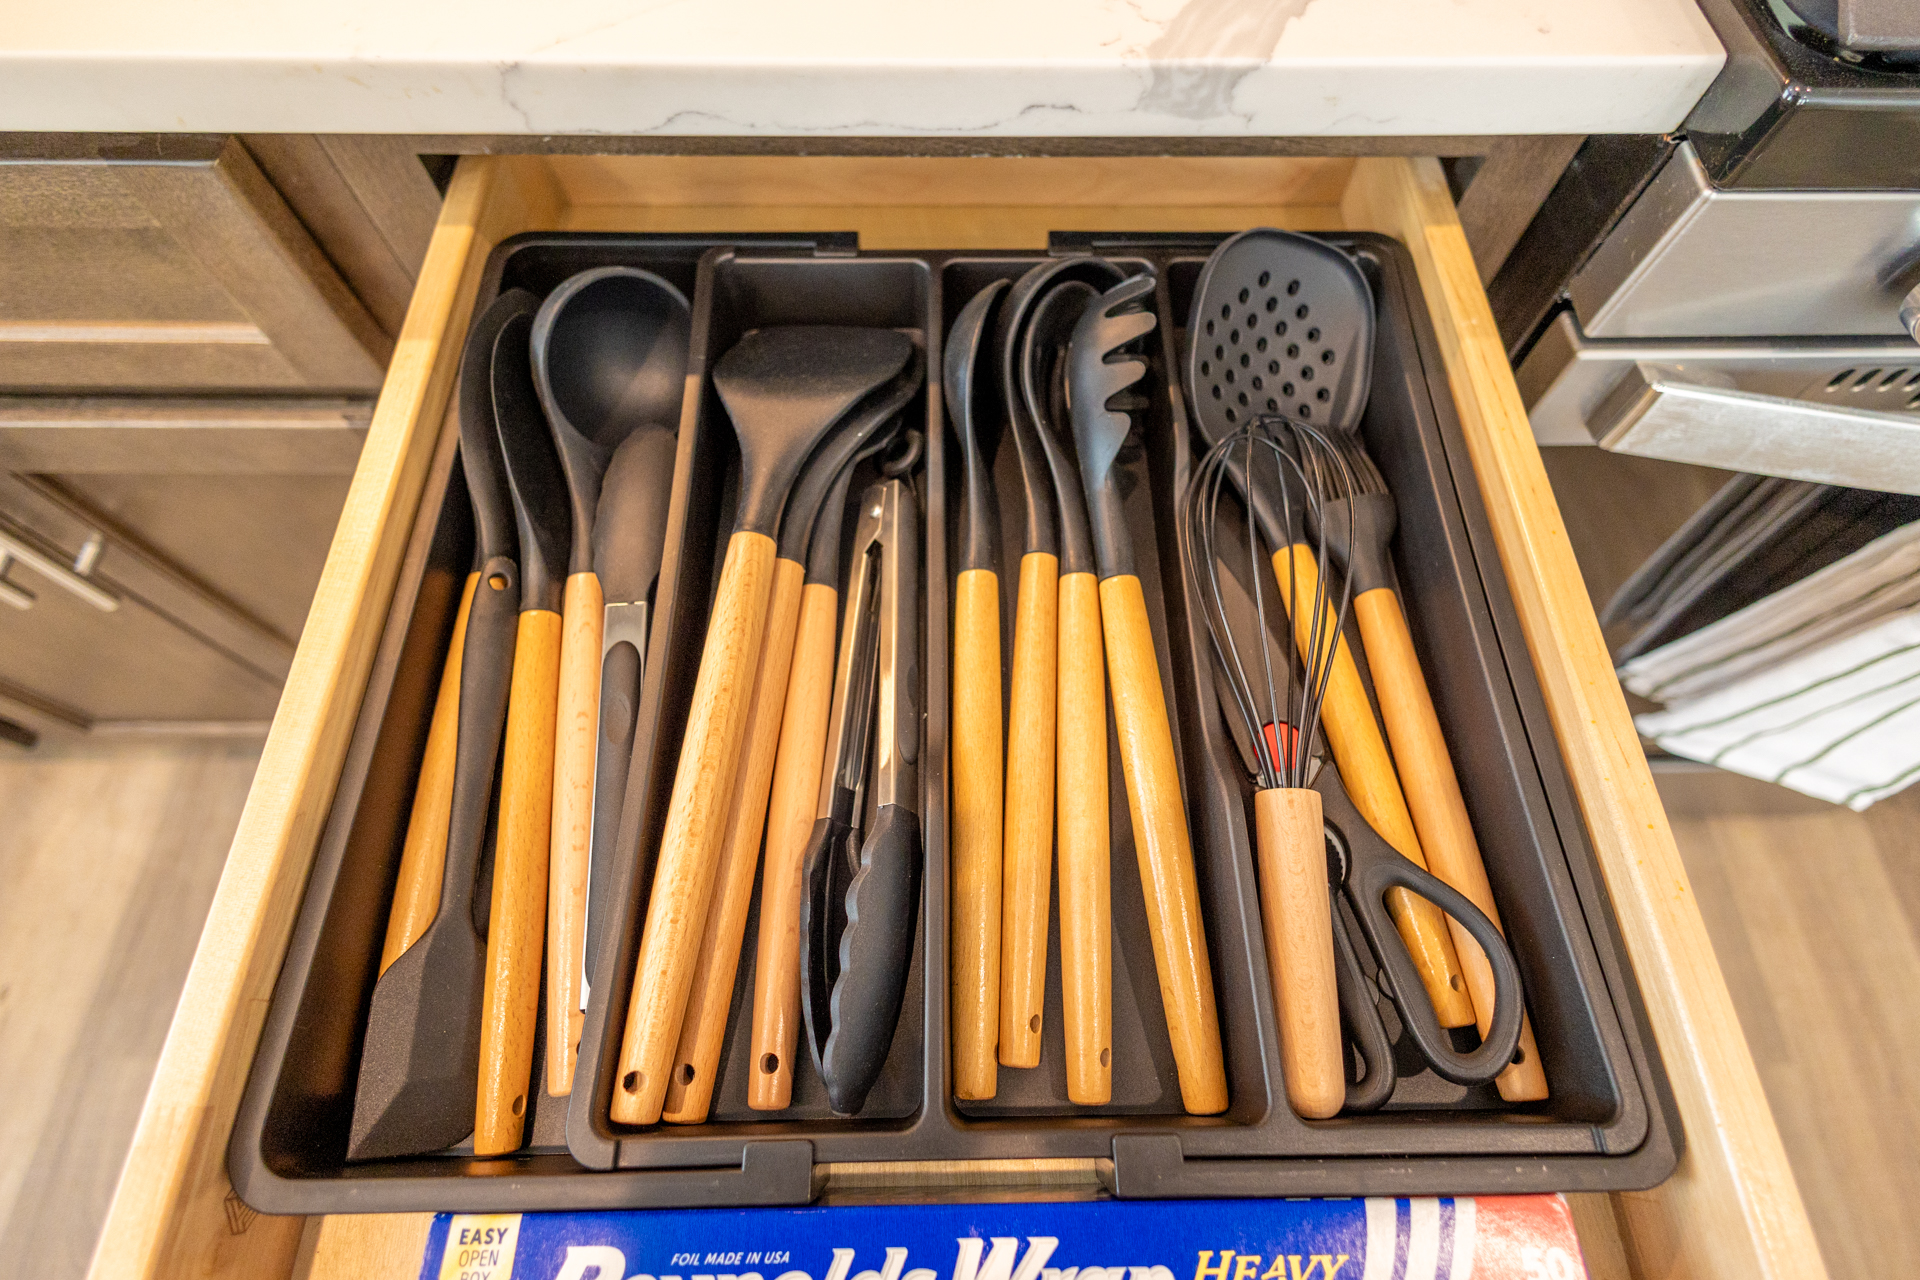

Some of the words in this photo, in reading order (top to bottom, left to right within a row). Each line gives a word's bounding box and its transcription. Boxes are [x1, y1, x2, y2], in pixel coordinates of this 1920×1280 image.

[458, 1227, 509, 1246] EASY
[458, 1249, 500, 1268] OPEN
[670, 1252, 700, 1267] FOIL
[704, 1251, 744, 1266] MADE
[745, 1251, 762, 1265] IN
[764, 1250, 791, 1265] USA
[1193, 1250, 1350, 1280] HEAVY
